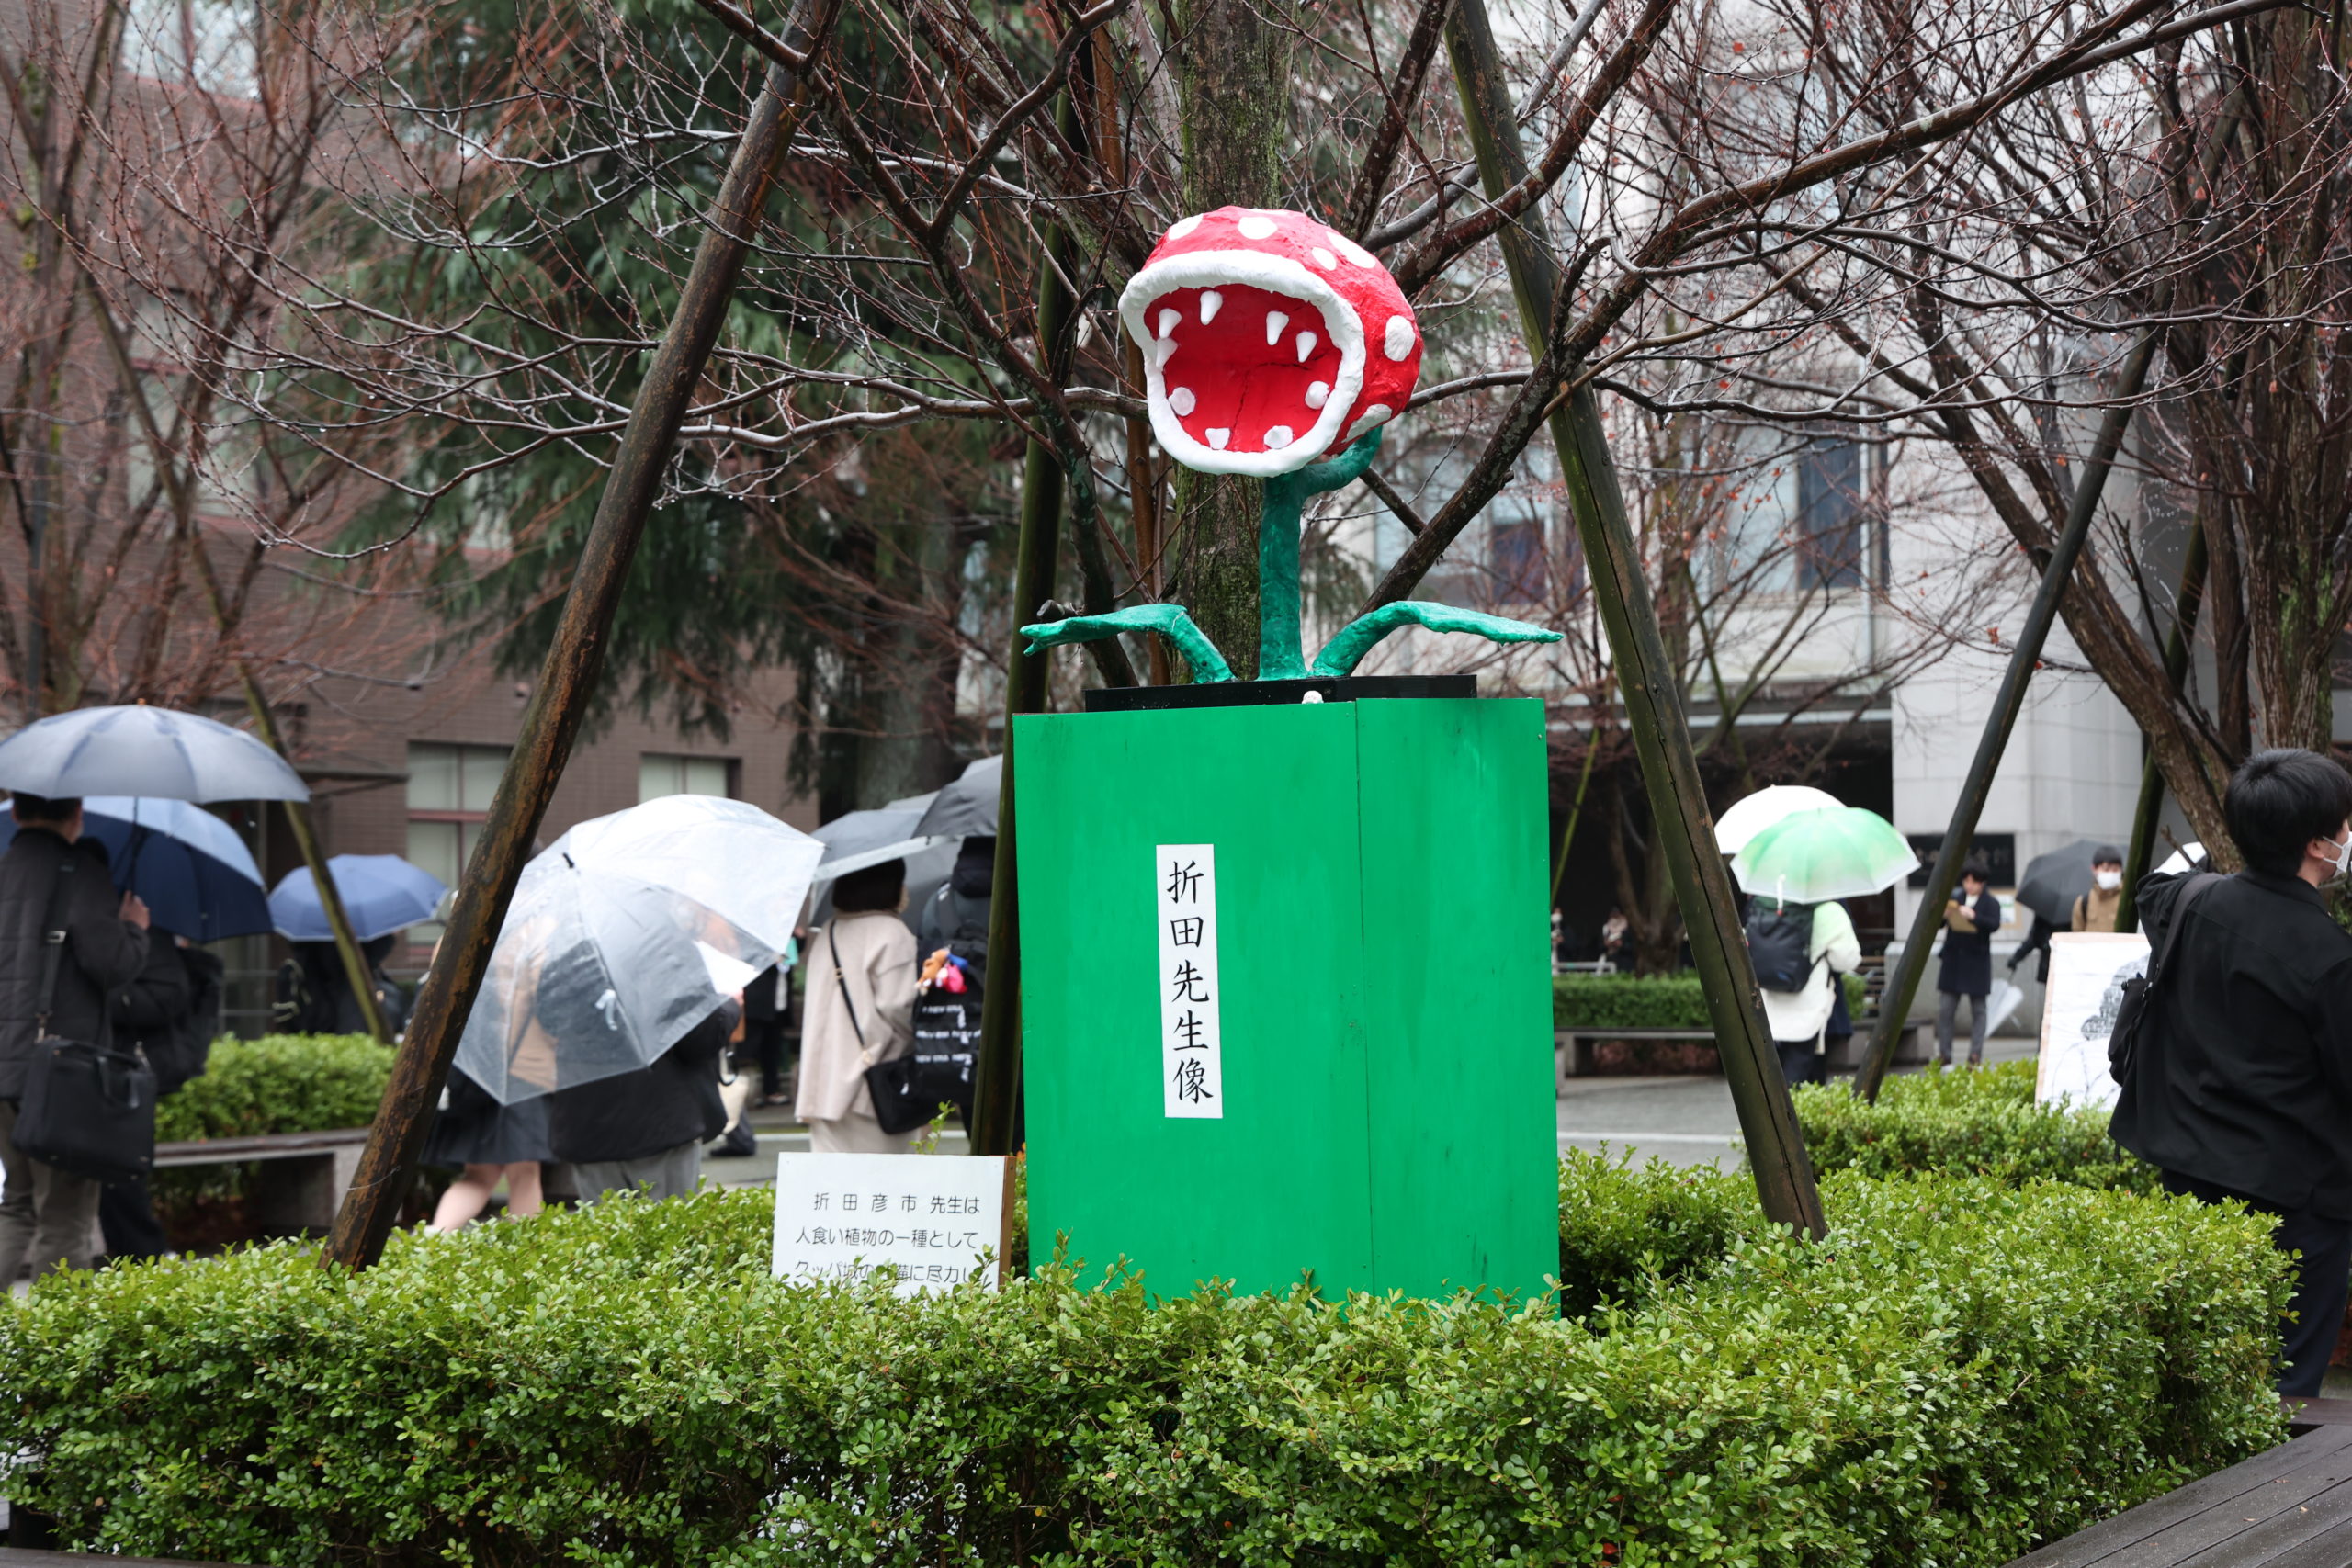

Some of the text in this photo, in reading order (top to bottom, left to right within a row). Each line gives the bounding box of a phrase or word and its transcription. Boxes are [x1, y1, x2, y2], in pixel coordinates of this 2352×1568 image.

[1166, 860, 1214, 1105] 折田先生像
[795, 1225, 978, 1249] 人食い植物の一種として
